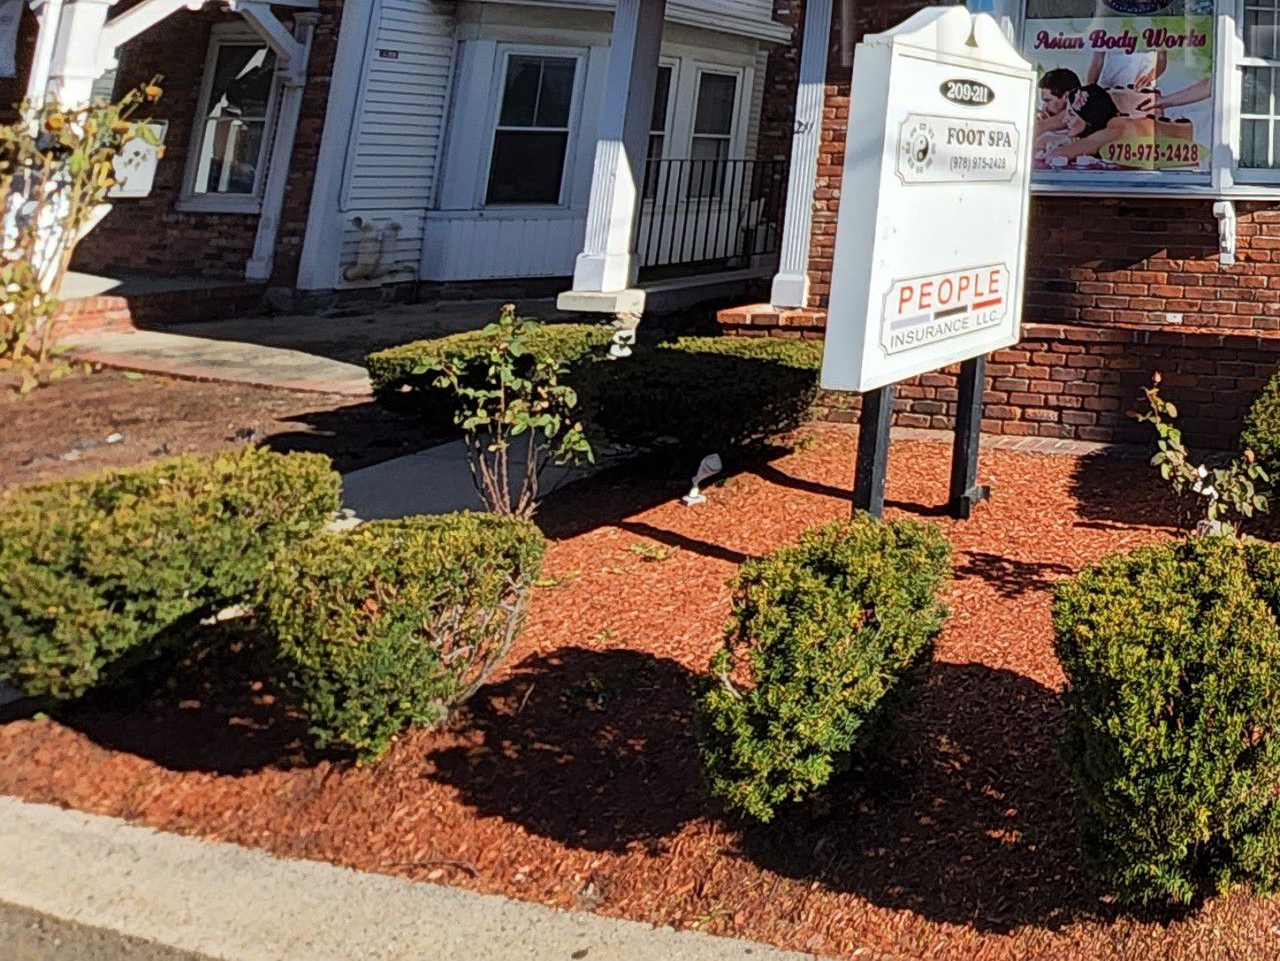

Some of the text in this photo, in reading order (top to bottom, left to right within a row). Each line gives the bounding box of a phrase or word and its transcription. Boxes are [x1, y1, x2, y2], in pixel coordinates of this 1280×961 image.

[1034, 27, 1206, 55] Asian Body Works
[946, 127, 1013, 148] FOOT SPA
[949, 155, 971, 172] (978)
[1108, 143, 1199, 162] 978-975-2428
[898, 269, 1001, 315] PEOPLE
[890, 316, 970, 348] INSURANCE
